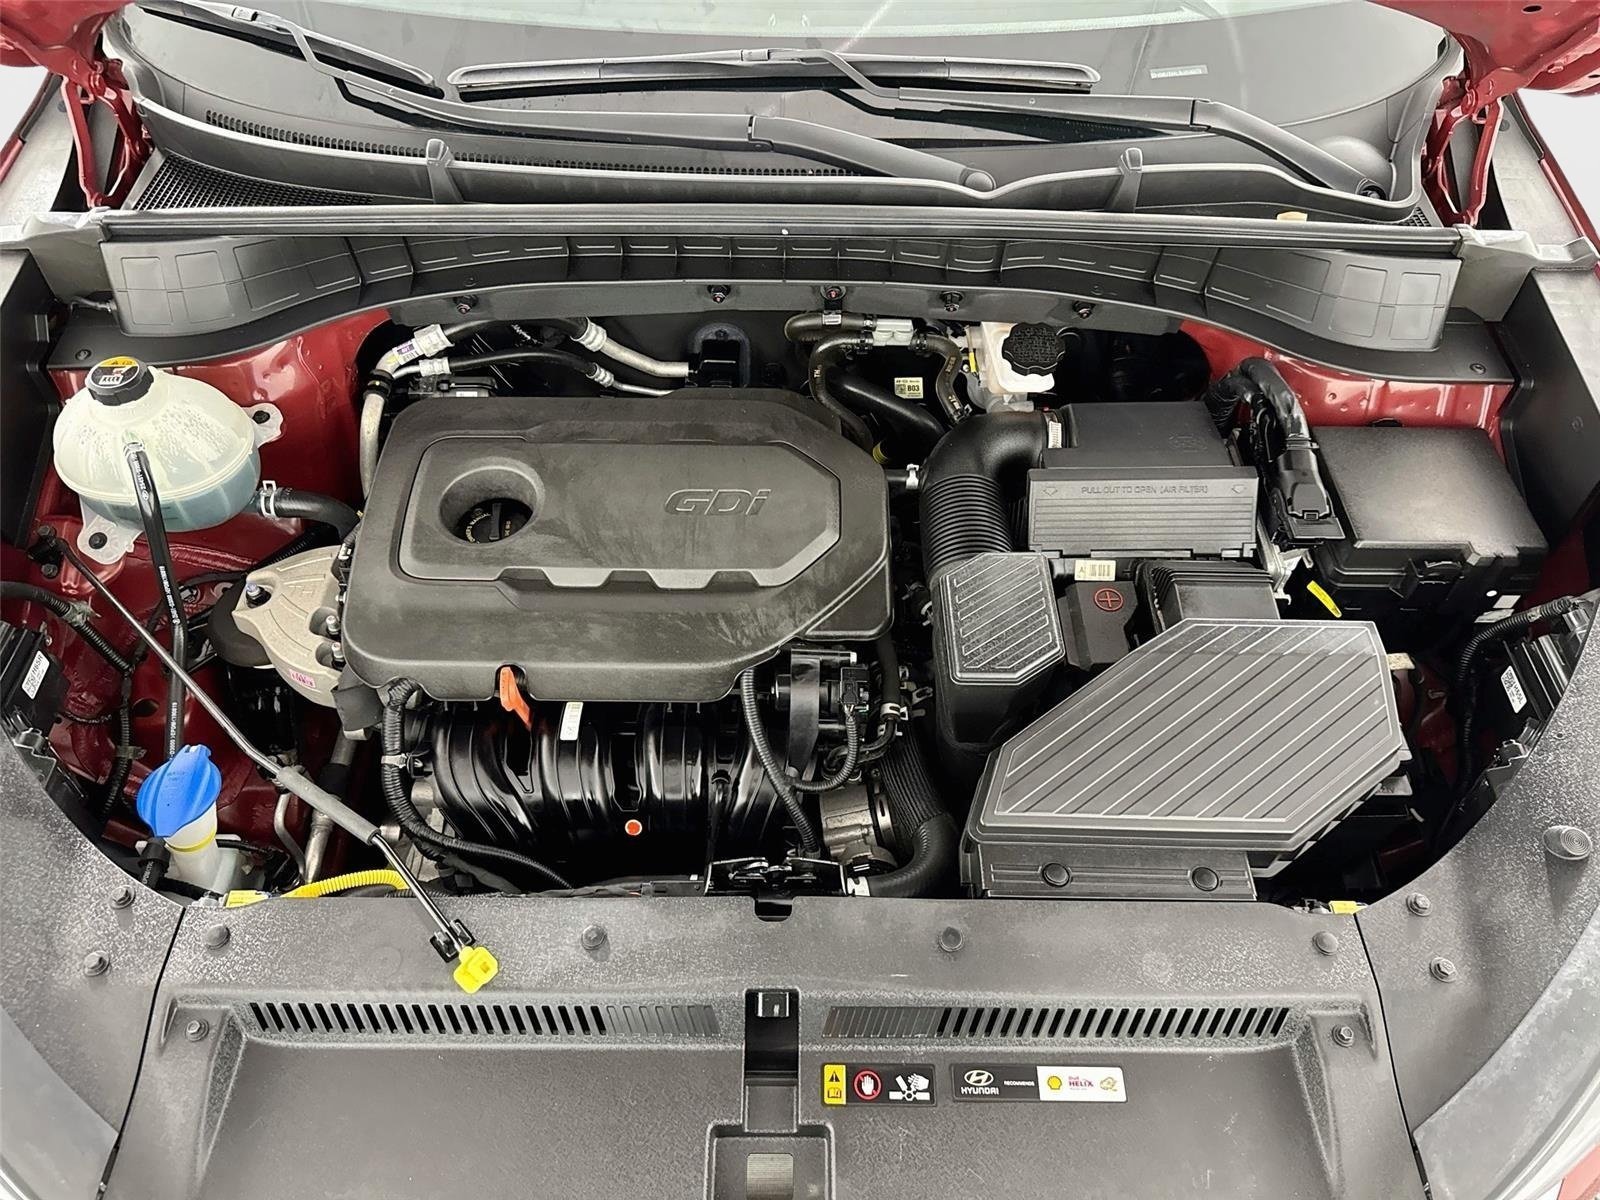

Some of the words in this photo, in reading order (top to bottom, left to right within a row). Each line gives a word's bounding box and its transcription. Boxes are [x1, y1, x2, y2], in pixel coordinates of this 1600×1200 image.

[1081, 486, 1102, 494] PULL
[1103, 486, 1120, 494] OUT
[1121, 485, 1133, 494] TO
[1134, 485, 1157, 494] OPEN
[664, 488, 771, 515] GDi
[960, 1086, 999, 1095] HYUNDAI
[1069, 1079, 1094, 1087] HELIX
